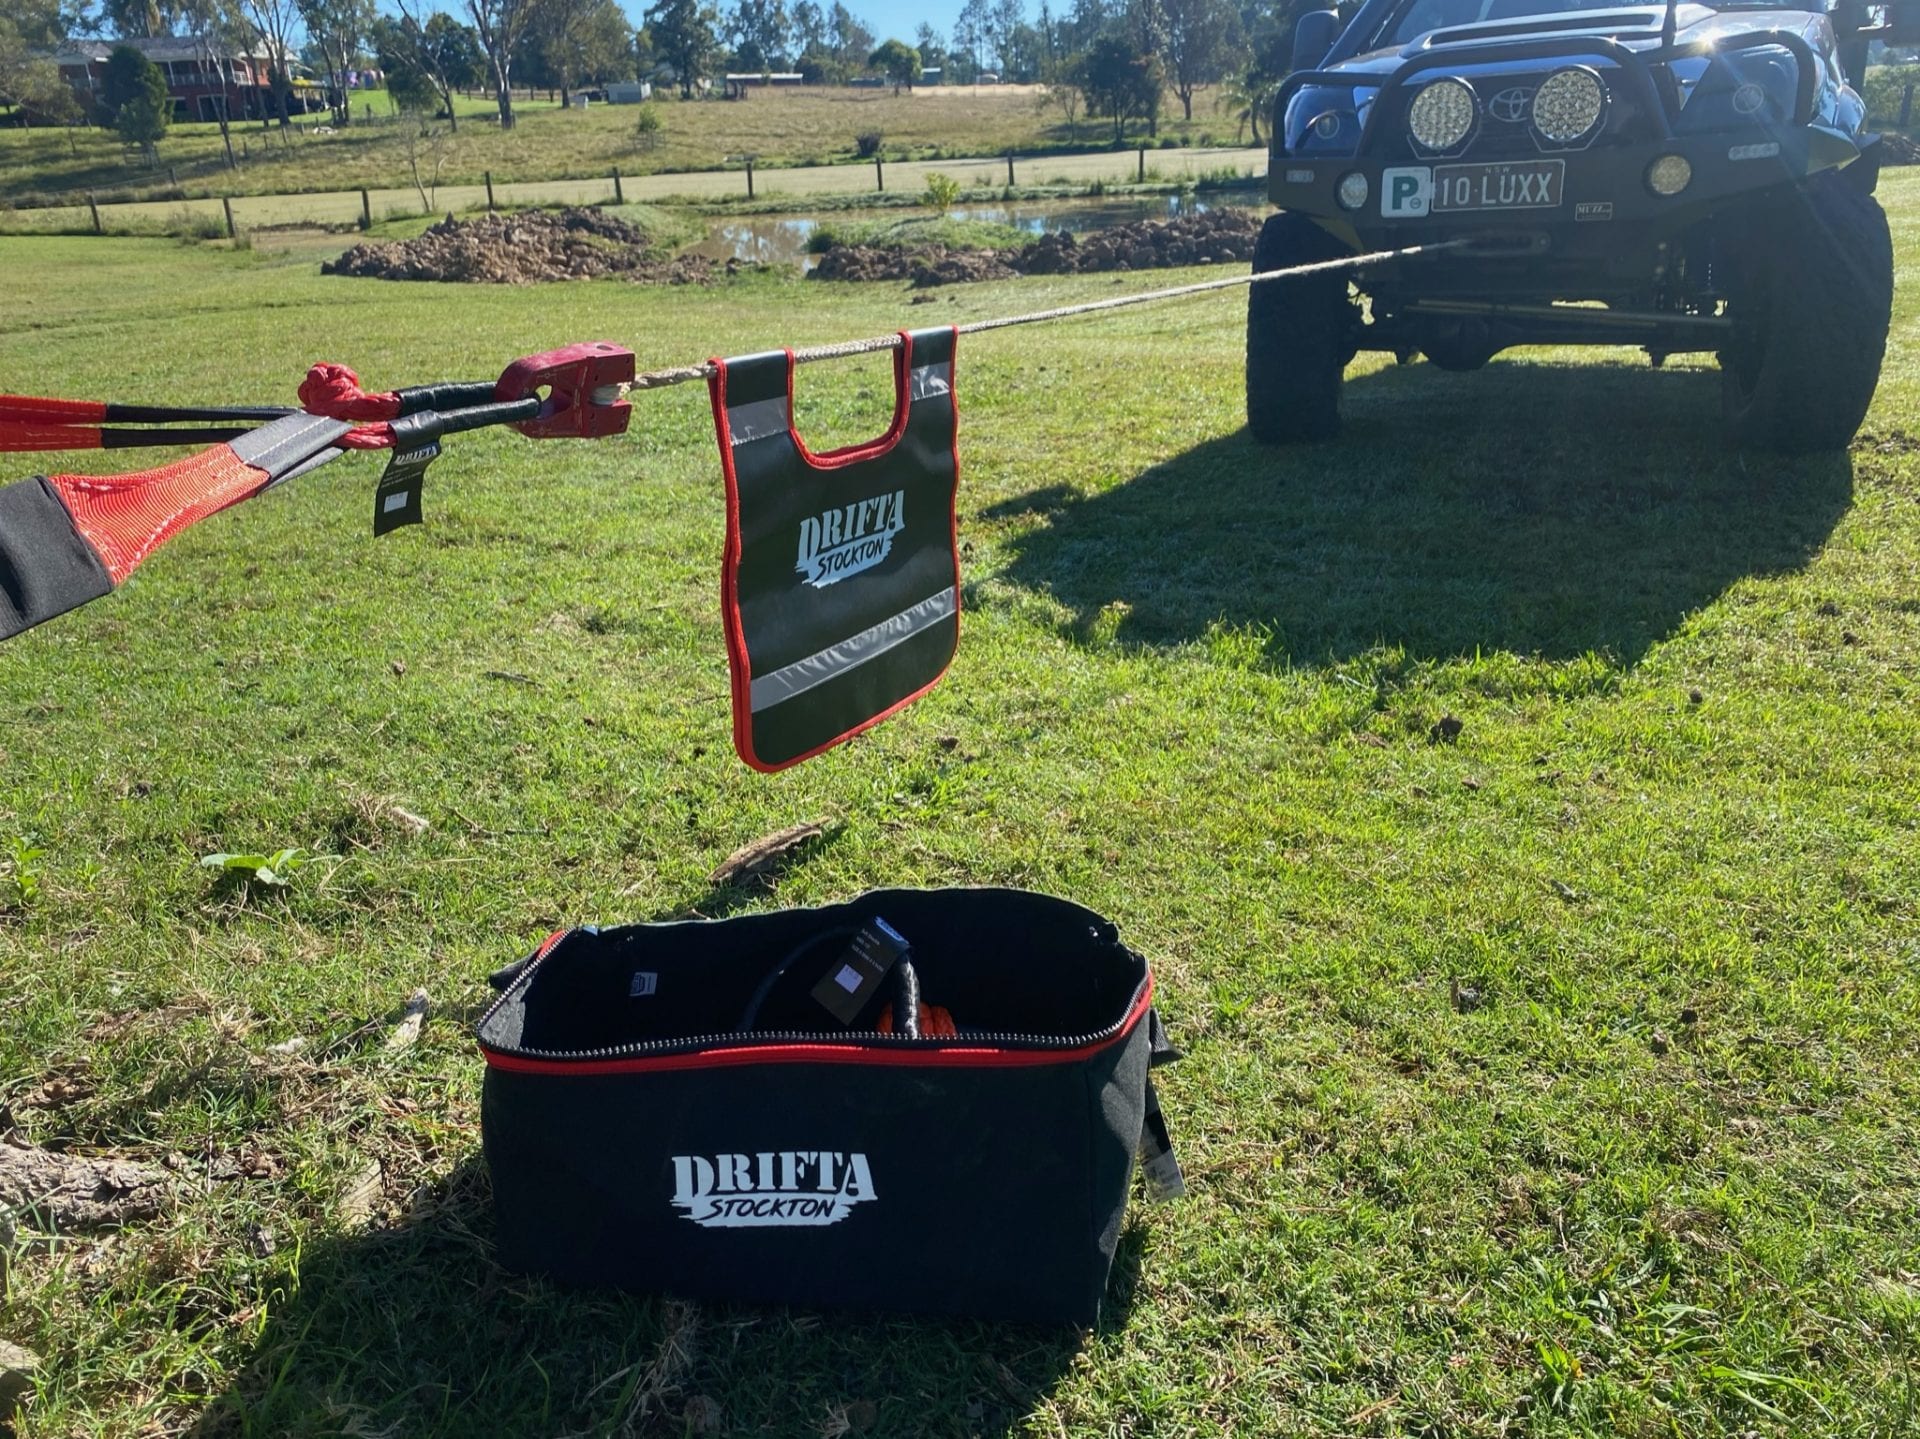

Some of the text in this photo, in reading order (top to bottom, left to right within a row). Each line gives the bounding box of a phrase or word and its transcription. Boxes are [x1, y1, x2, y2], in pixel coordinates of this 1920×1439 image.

[1392, 176, 1418, 210] P
[798, 490, 905, 562] DRIFTA
[813, 538, 885, 582] STOCKTON
[670, 1151, 878, 1201] DRIFTA
[697, 1198, 836, 1221] STOCKTON
